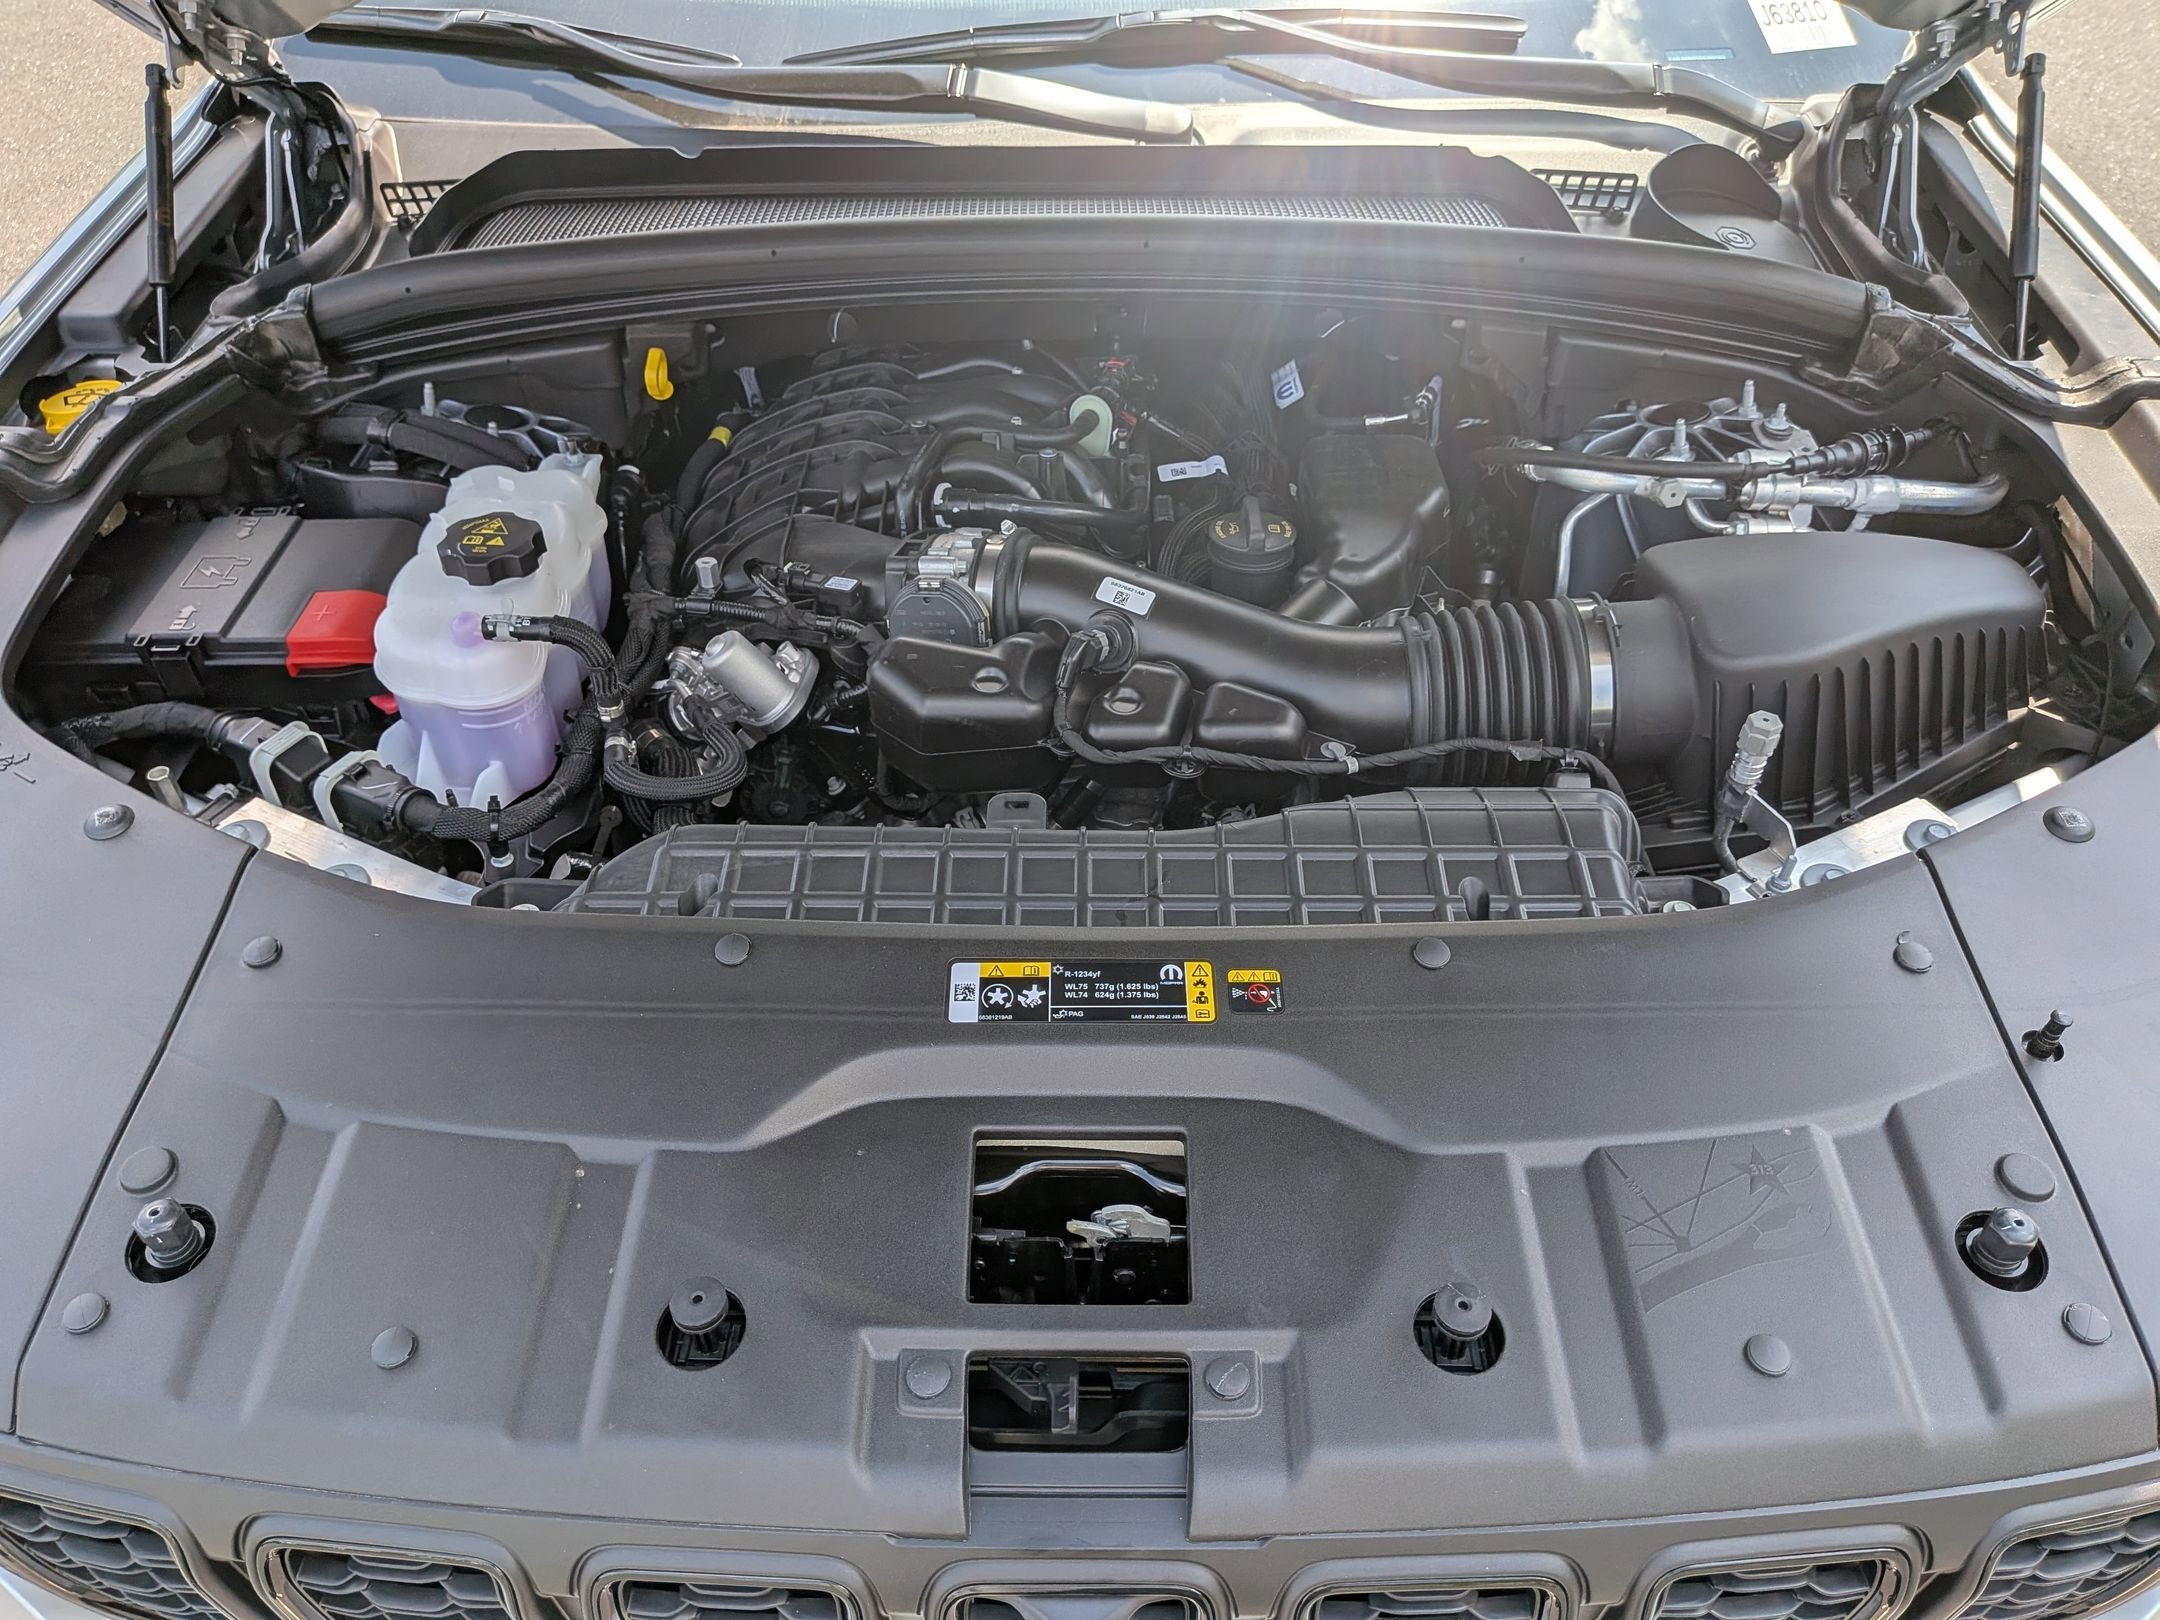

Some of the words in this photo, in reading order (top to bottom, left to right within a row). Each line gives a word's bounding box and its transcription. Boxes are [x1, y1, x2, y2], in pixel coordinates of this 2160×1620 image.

[1761, 0, 1827, 25] J63810
[1064, 971, 1101, 979] R-1234yf
[1094, 983, 1115, 991] 737g
[1116, 983, 1141, 991] (1.625
[1143, 983, 1159, 991] lbs)
[1750, 1163, 1774, 1176] 313
